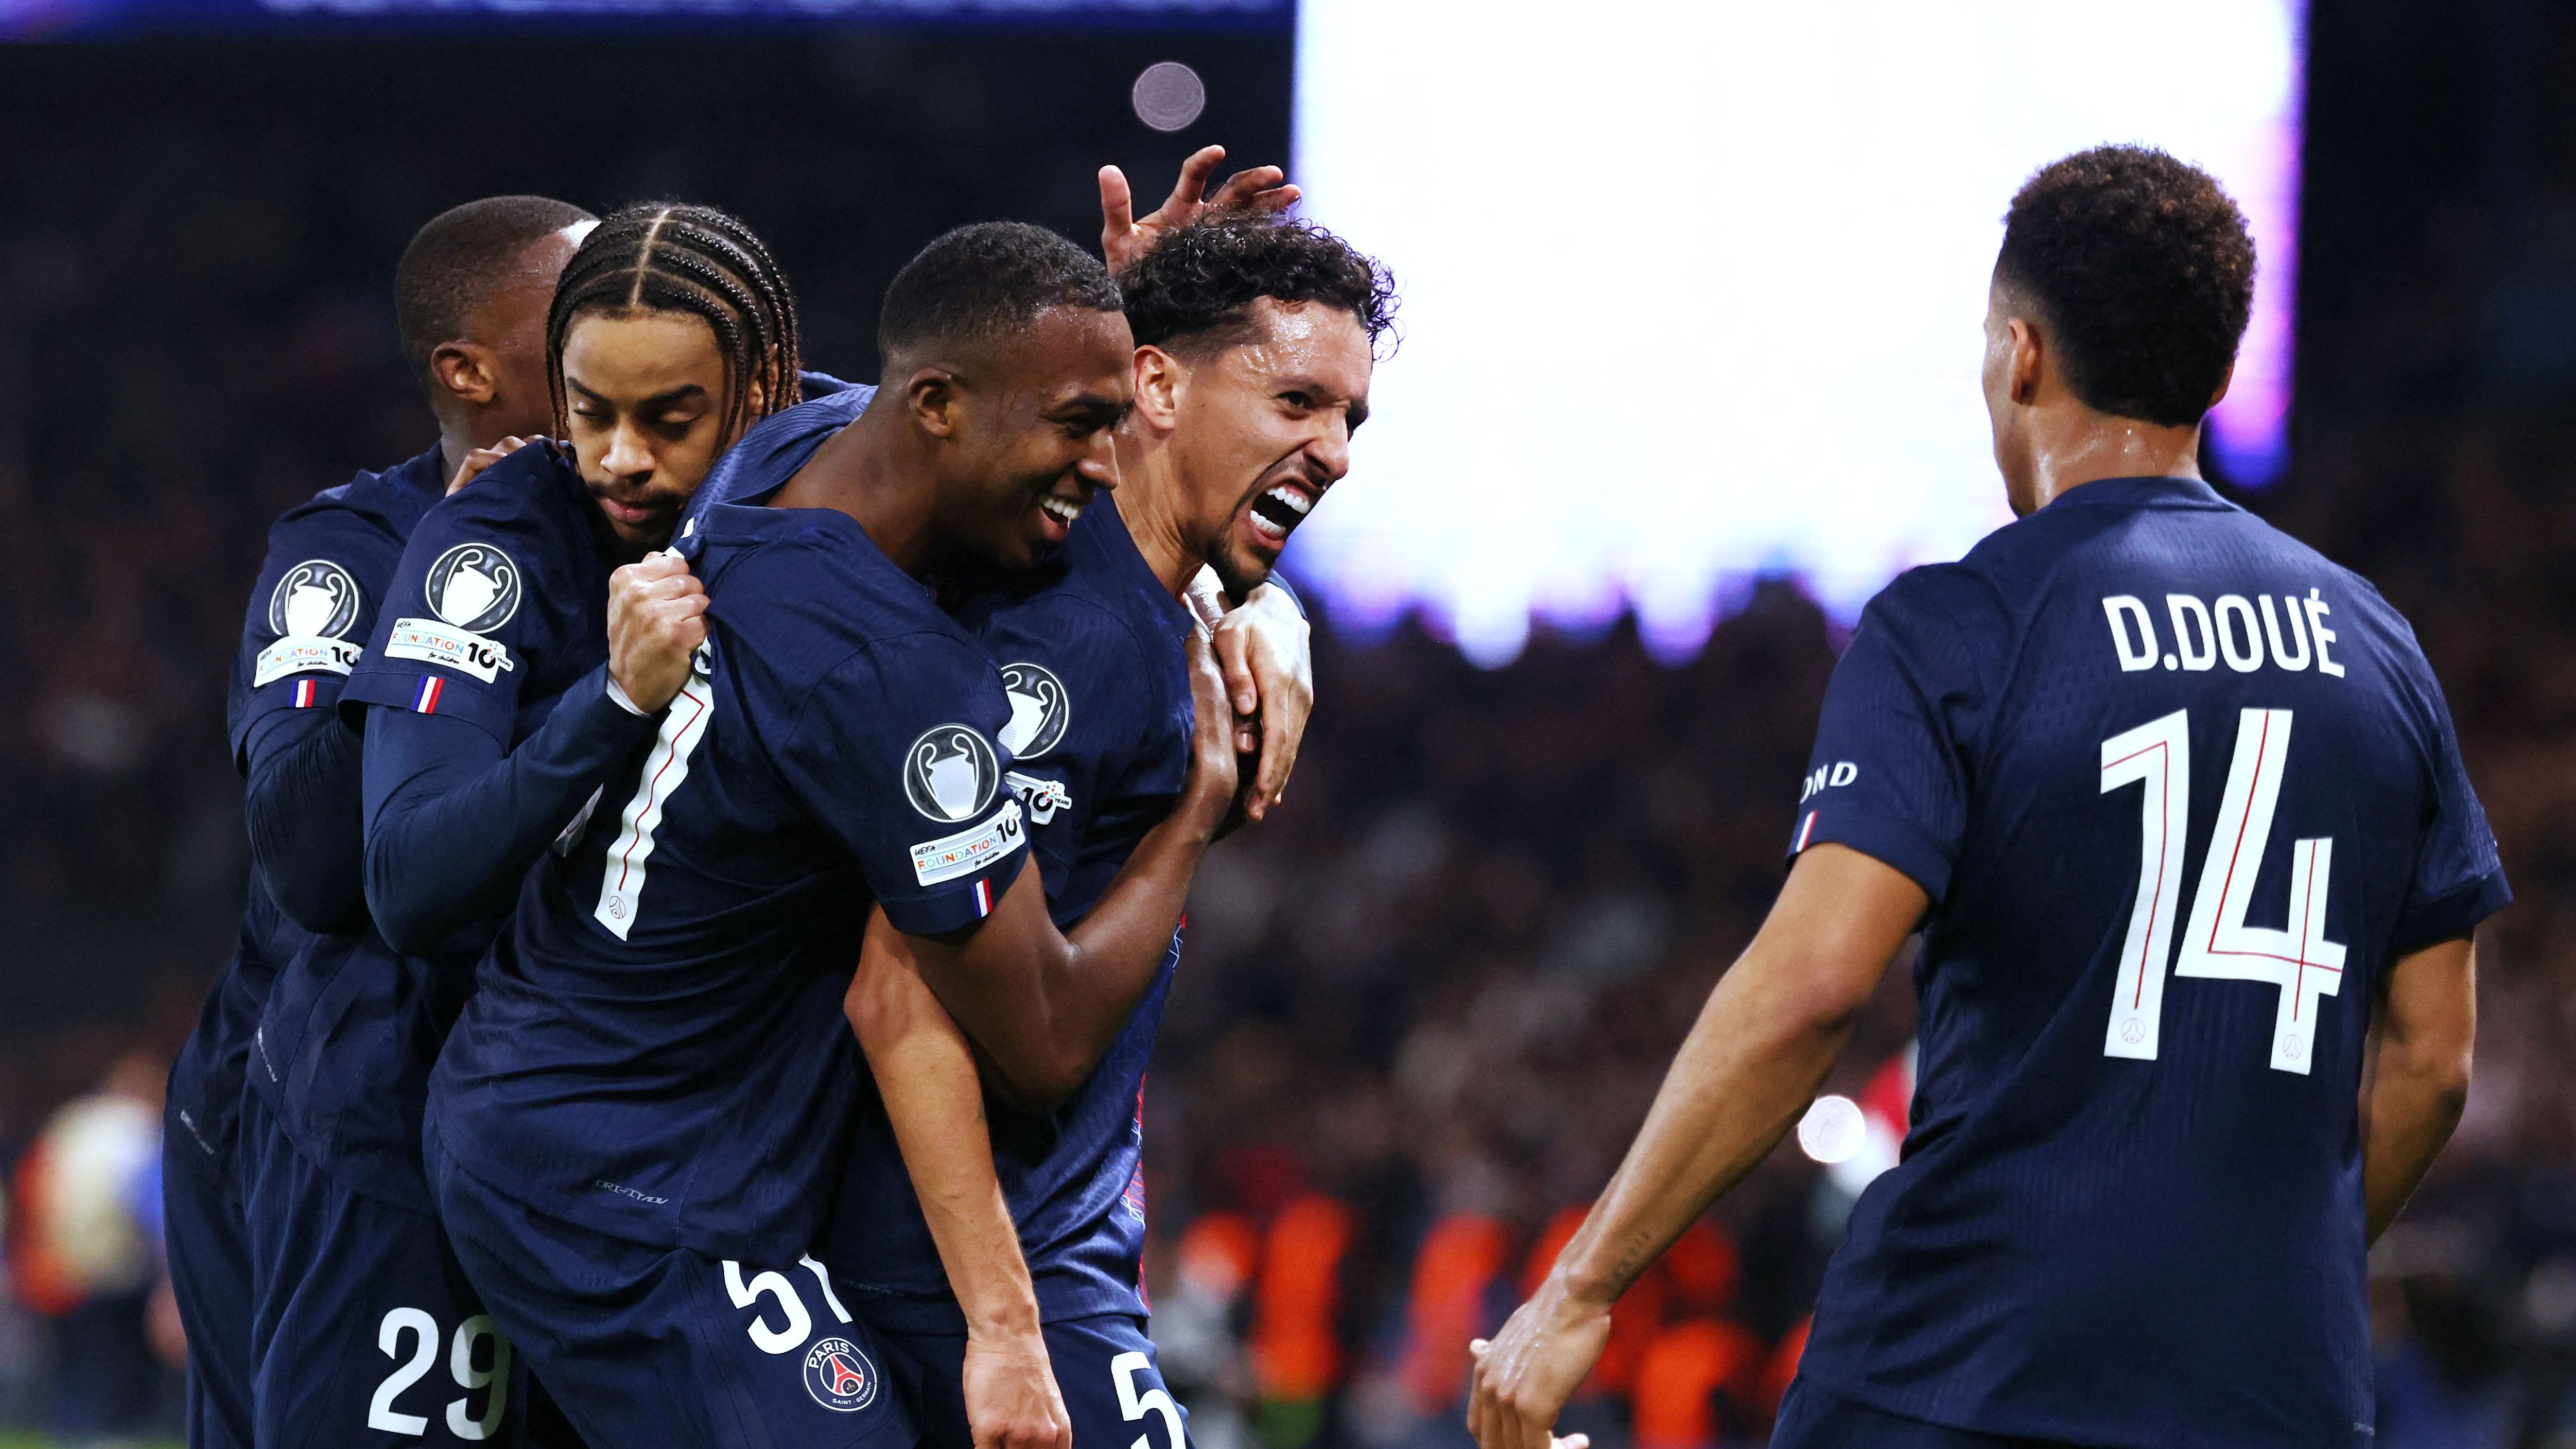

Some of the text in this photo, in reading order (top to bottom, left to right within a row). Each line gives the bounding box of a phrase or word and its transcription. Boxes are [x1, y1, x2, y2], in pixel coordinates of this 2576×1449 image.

[468, 642, 496, 669] 10
[2102, 588, 2344, 678] D.DOUÉ
[914, 845, 936, 856] UEFA
[996, 818, 1017, 843] 10
[2100, 708, 2347, 1076] 14
[722, 1253, 853, 1355] 51
[368, 1307, 511, 1440] 29
[808, 1341, 850, 1369] PARIS
[1111, 1351, 1186, 1449] 5
